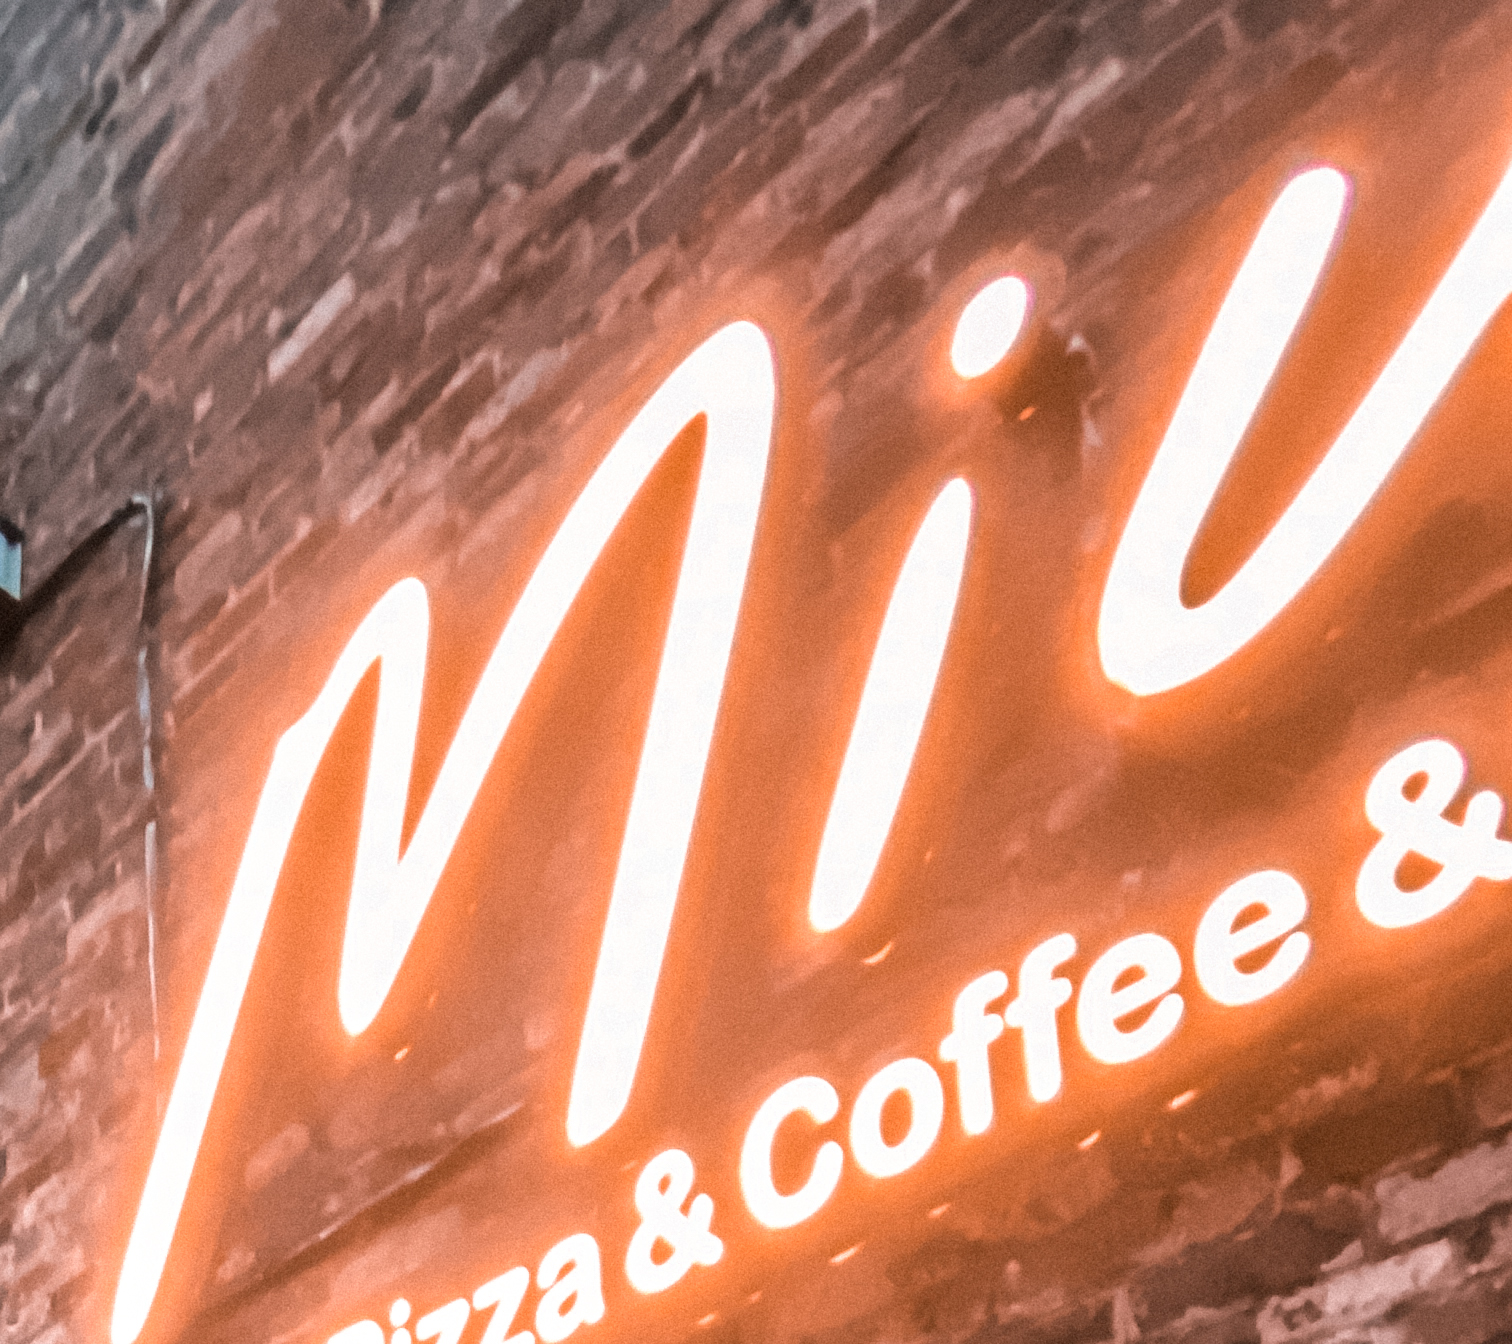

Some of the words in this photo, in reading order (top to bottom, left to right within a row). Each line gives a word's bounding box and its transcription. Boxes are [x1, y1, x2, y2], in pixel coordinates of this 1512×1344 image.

[625, 1148, 725, 1294] &
[739, 869, 1311, 1229] Coffee
[1355, 738, 1512, 929] &
